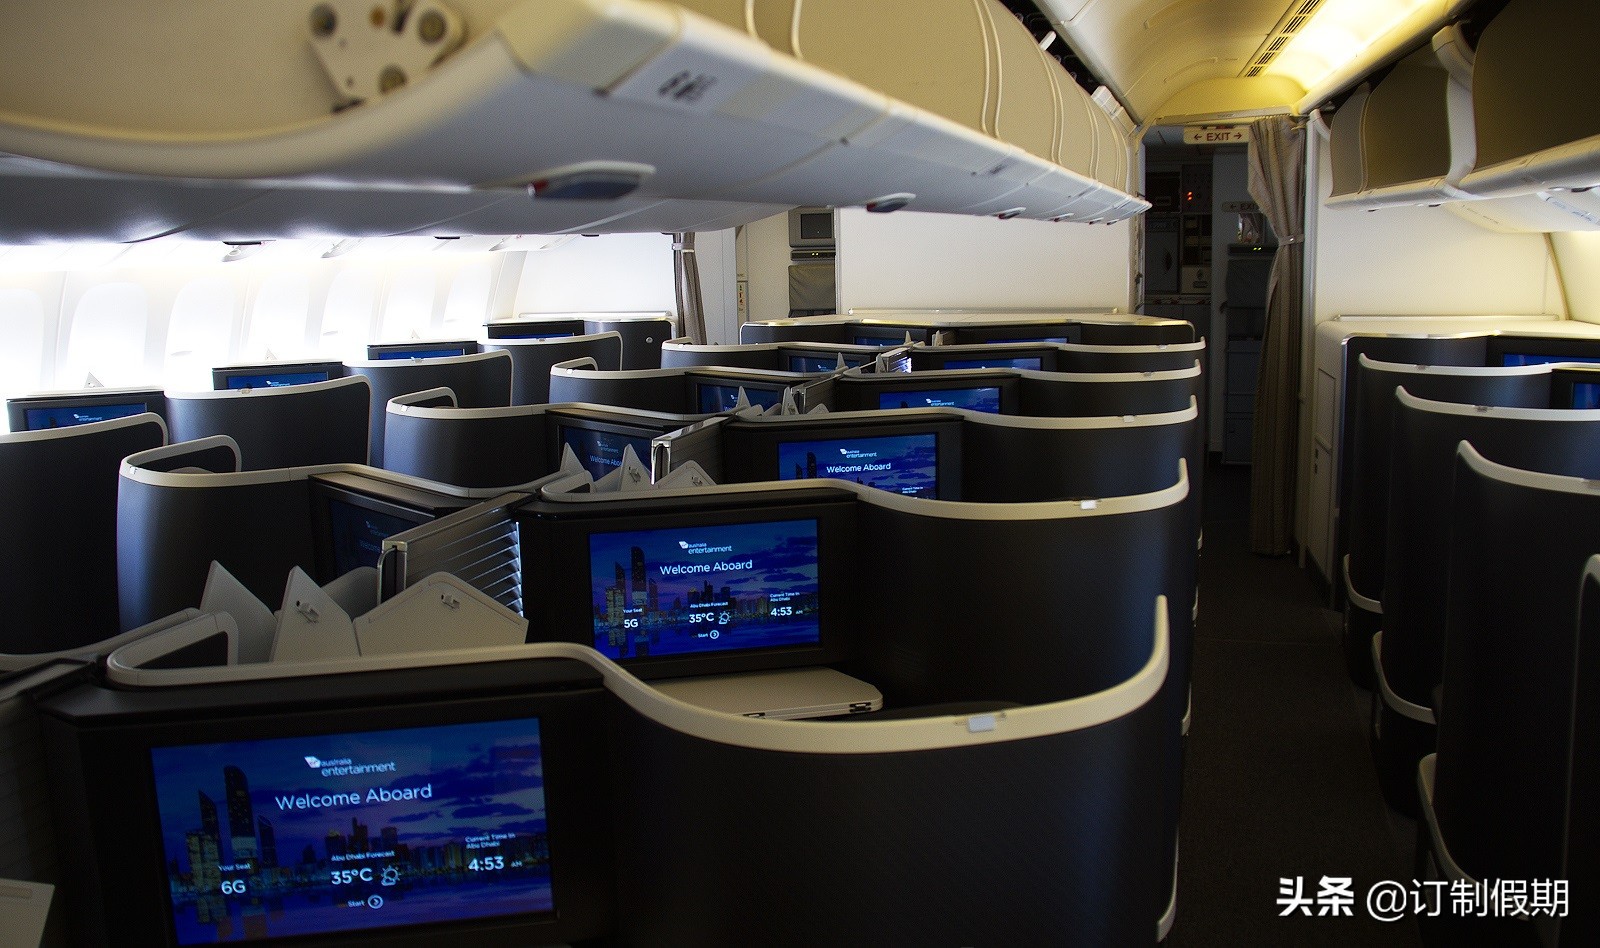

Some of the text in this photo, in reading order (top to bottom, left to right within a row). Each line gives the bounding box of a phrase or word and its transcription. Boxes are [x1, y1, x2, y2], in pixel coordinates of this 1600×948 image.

[1206, 132, 1231, 142] EXIT
[827, 462, 891, 473] Welcome Aboard
[688, 545, 732, 554] entertainment
[660, 559, 752, 575] Welcome Aboard
[770, 606, 793, 616] 4:53
[623, 618, 639, 628] 5G
[689, 612, 715, 623] 35°C
[321, 762, 397, 777] entertainment
[274, 783, 433, 811] Welcome Aboard
[468, 855, 505, 871] 4:53
[331, 867, 374, 885] 35°C
[221, 879, 247, 895] 6G
[347, 899, 365, 908] Start
